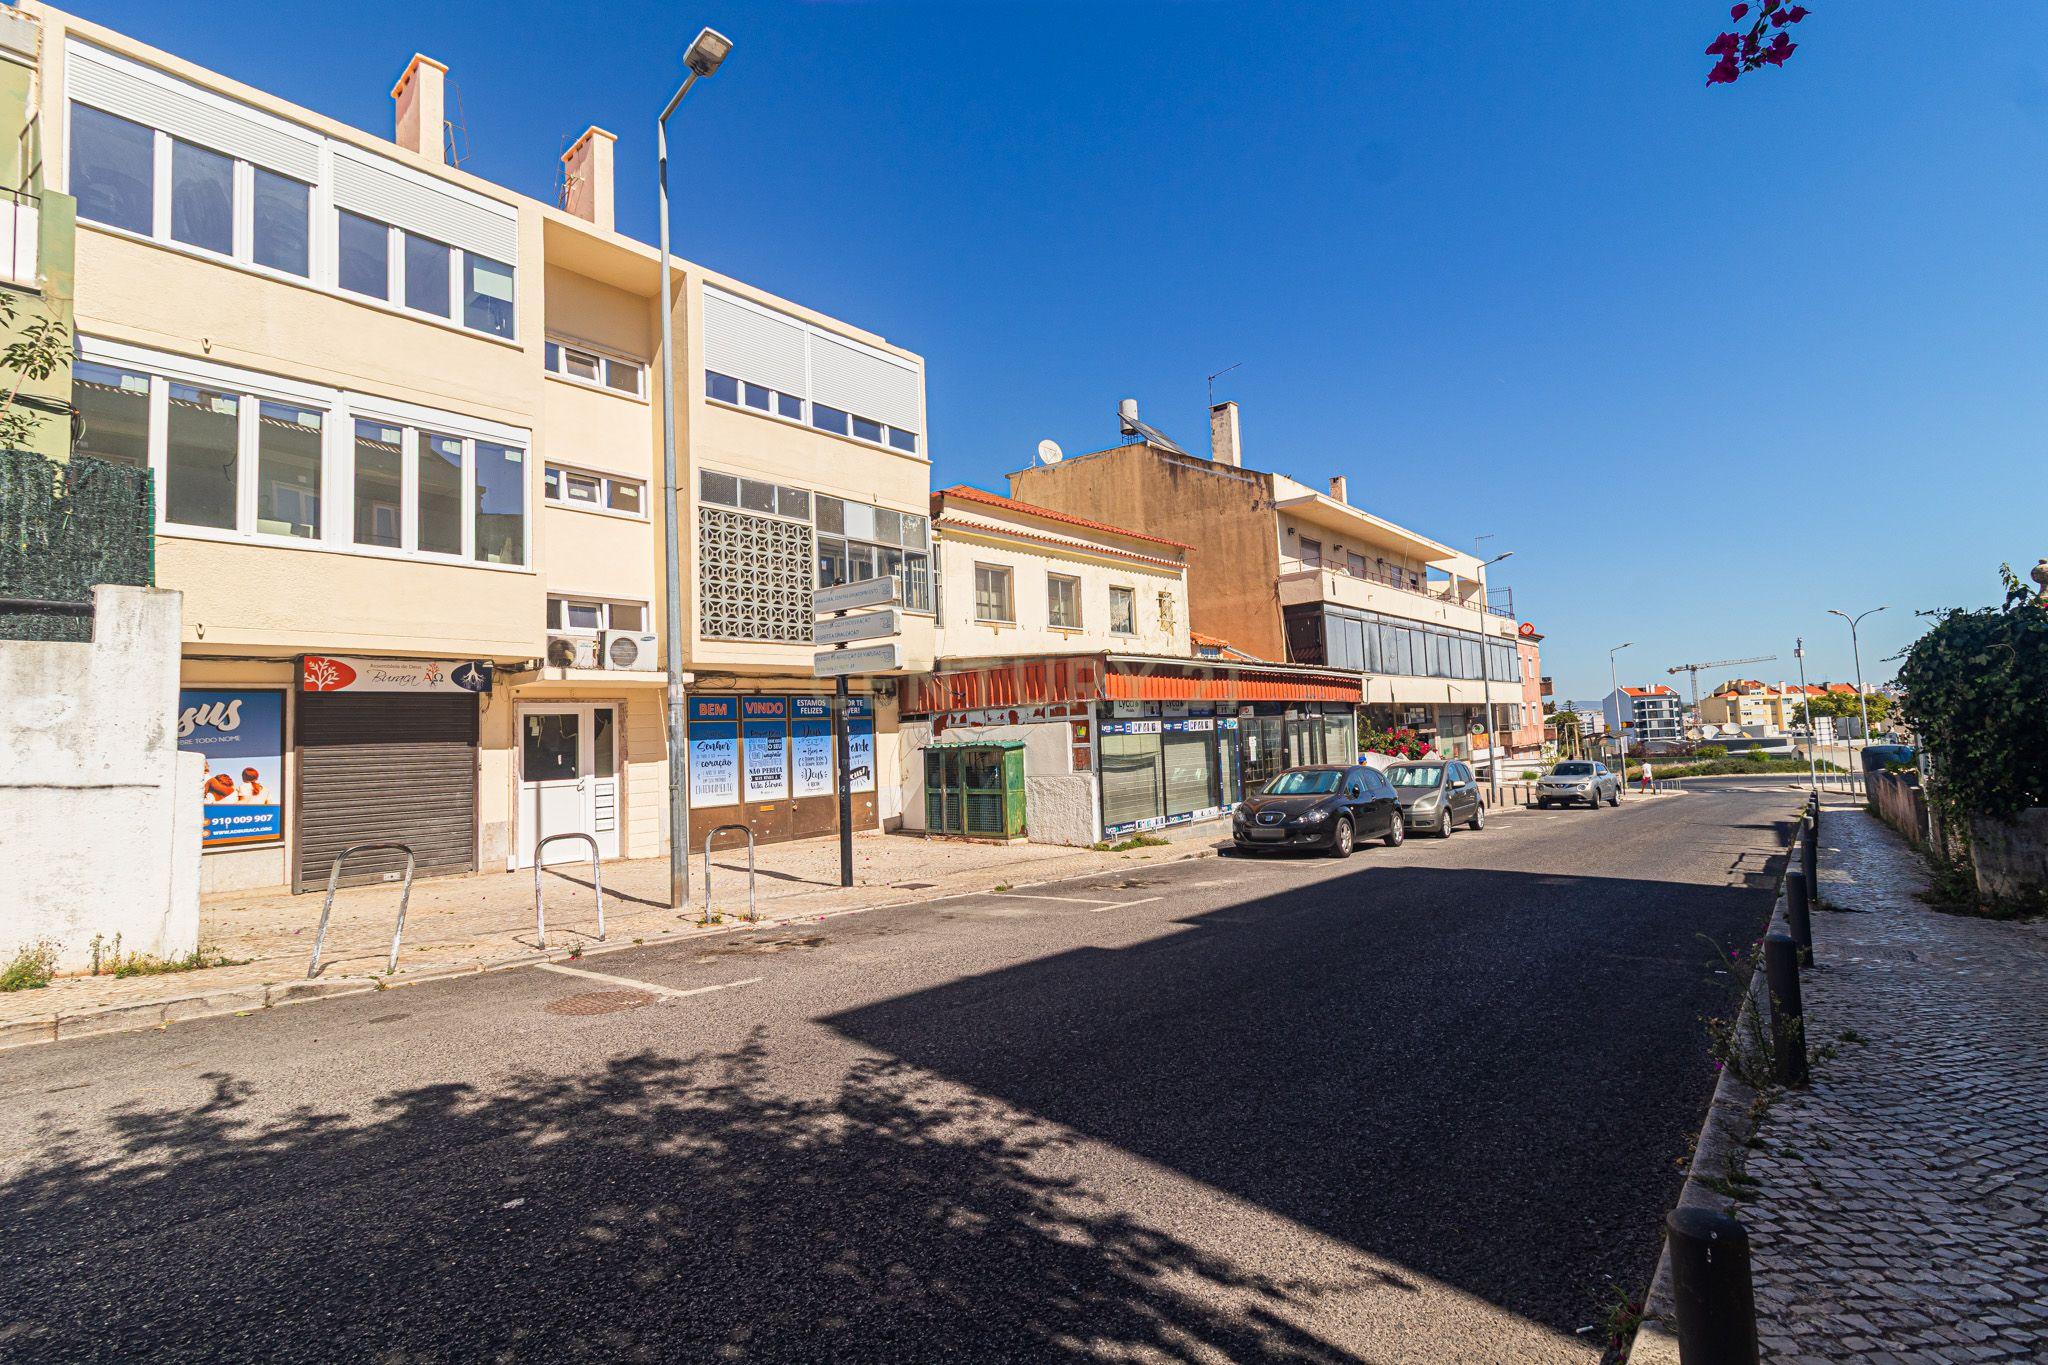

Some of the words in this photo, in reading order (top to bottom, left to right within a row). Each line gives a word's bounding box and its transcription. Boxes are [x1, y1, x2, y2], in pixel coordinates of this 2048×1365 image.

[797, 699, 826, 707] ESTAMOS
[699, 703, 727, 716] BEM
[745, 702, 784, 715] VINDO
[800, 707, 823, 715] FELIZES
[195, 736, 217, 744] TODO
[218, 735, 241, 743] NOME
[697, 741, 730, 752] Senhor
[701, 759, 732, 769] coração
[212, 816, 232, 826] 910
[233, 815, 252, 824] 009
[254, 813, 273, 823] 907
